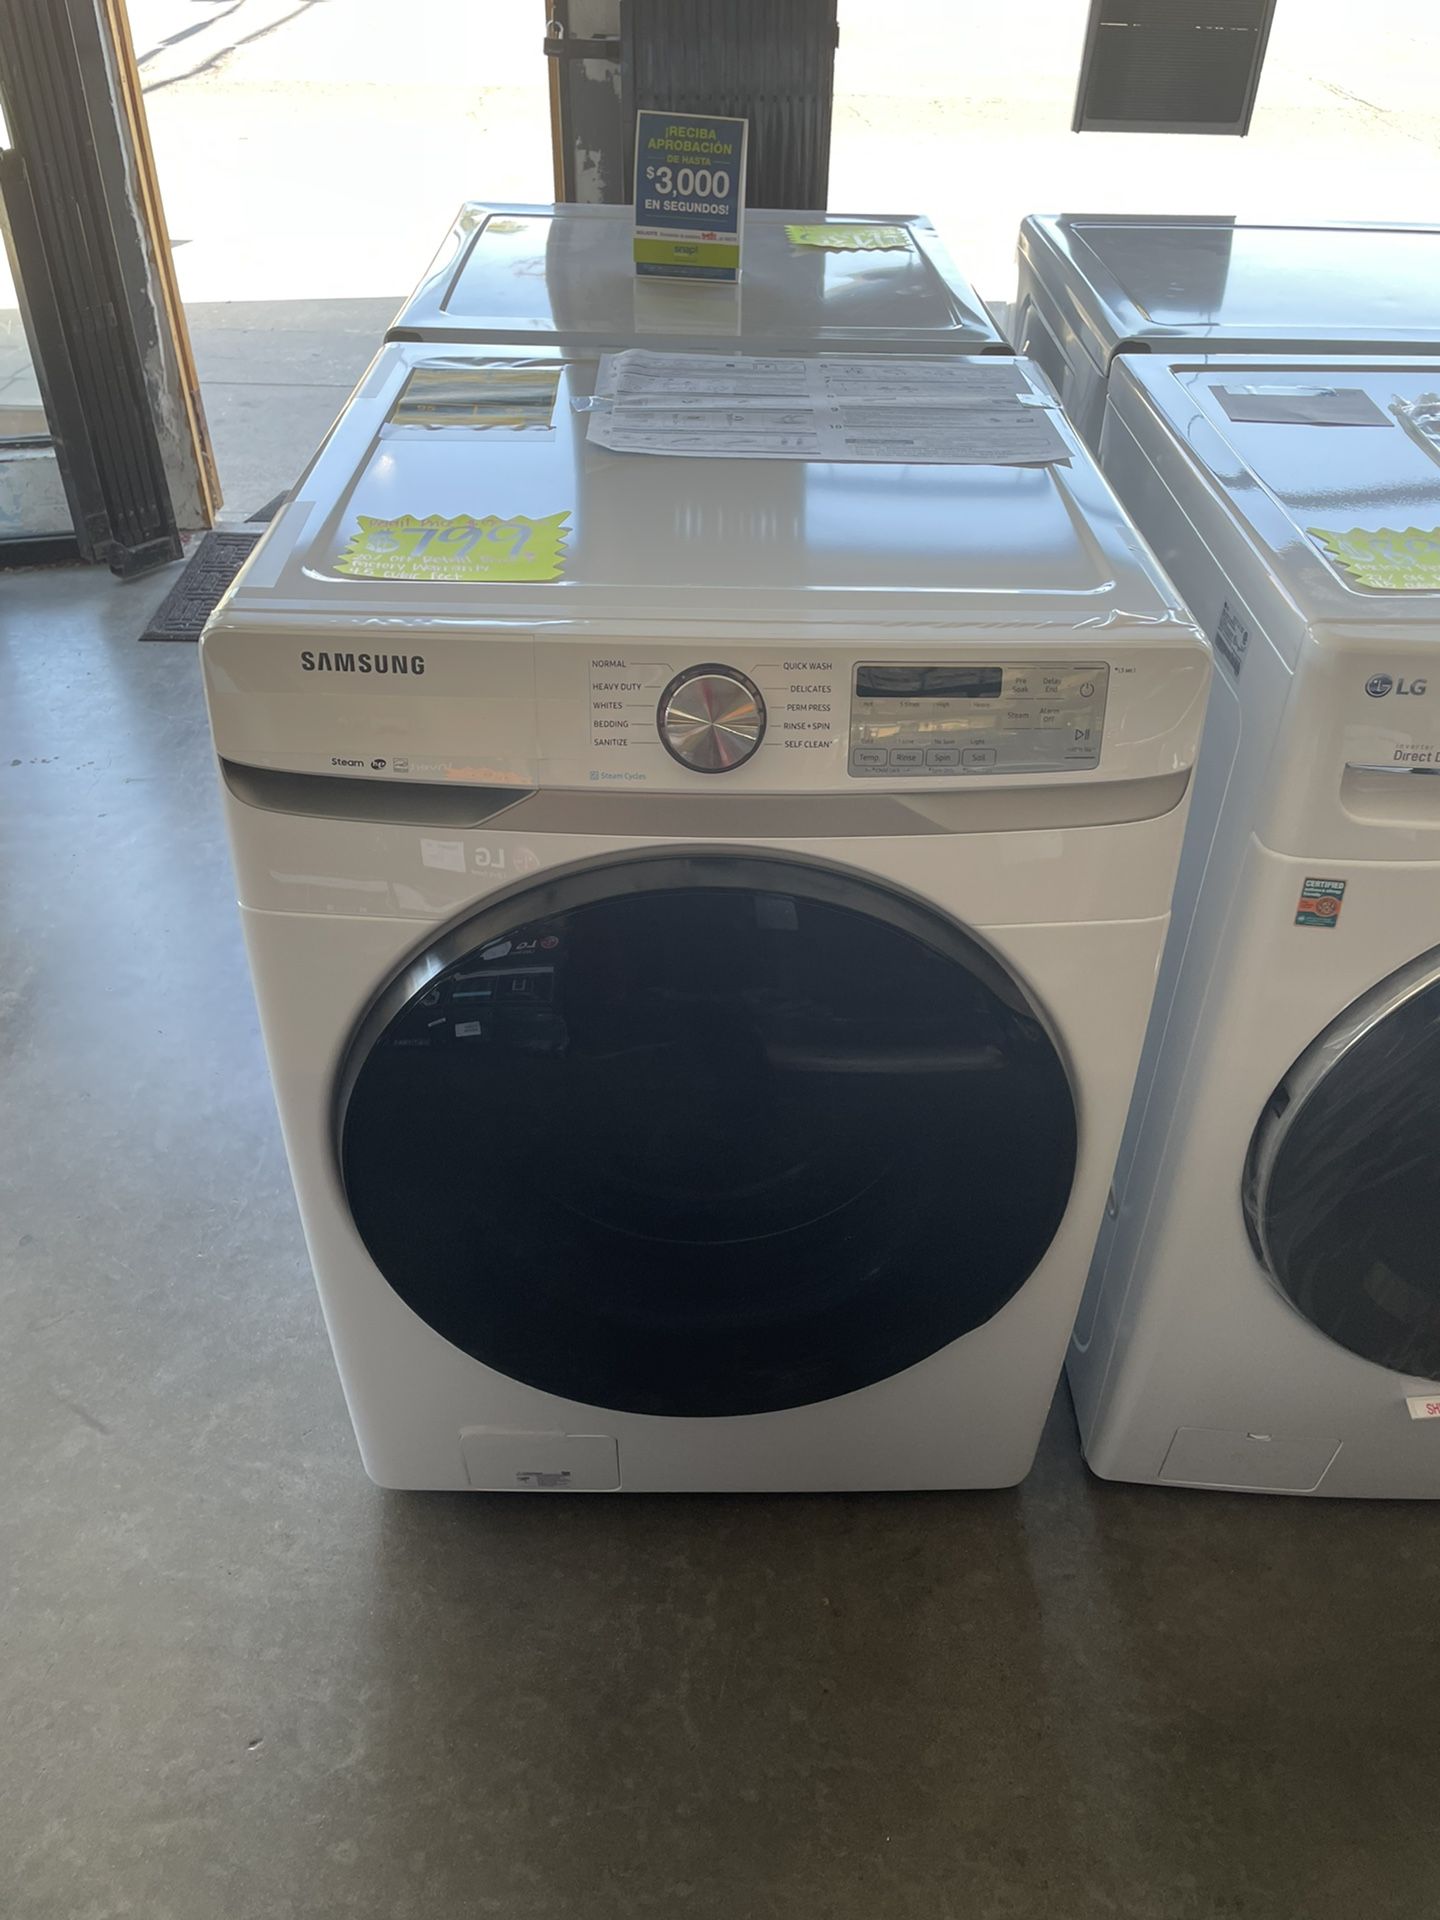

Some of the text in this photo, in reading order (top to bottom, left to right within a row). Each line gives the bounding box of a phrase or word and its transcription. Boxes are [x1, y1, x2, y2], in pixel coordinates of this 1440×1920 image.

[665, 126, 717, 140] ¡RECIBA
[648, 138, 733, 154] APROBACIÓN
[666, 155, 711, 165] DE HASTA
[646, 166, 730, 198] $3,000
[645, 199, 729, 216] EN SEGUNDOS!
[365, 527, 532, 557] $799
[301, 651, 425, 674] SAMSUNG
[592, 660, 626, 668] NORMAL
[783, 662, 832, 670] QUICK WASH
[593, 683, 641, 691] HEAVY DUTY
[790, 685, 831, 693] DELICATES
[1396, 678, 1427, 695] LG
[593, 702, 623, 710] WHITES
[786, 704, 831, 712] PERM PRESS
[1007, 711, 1029, 719] Steam
[593, 720, 629, 728] BEDDING
[784, 722, 806, 730] RINSE
[812, 722, 830, 730] SPIN
[594, 738, 628, 746] SANITIZE
[897, 753, 916, 761] Rinse
[935, 754, 951, 762] Spin
[972, 753, 986, 761] Soil
[1394, 750, 1432, 762] Direct
[331, 757, 364, 768] Steam
[601, 771, 646, 781] Steam Cycles
